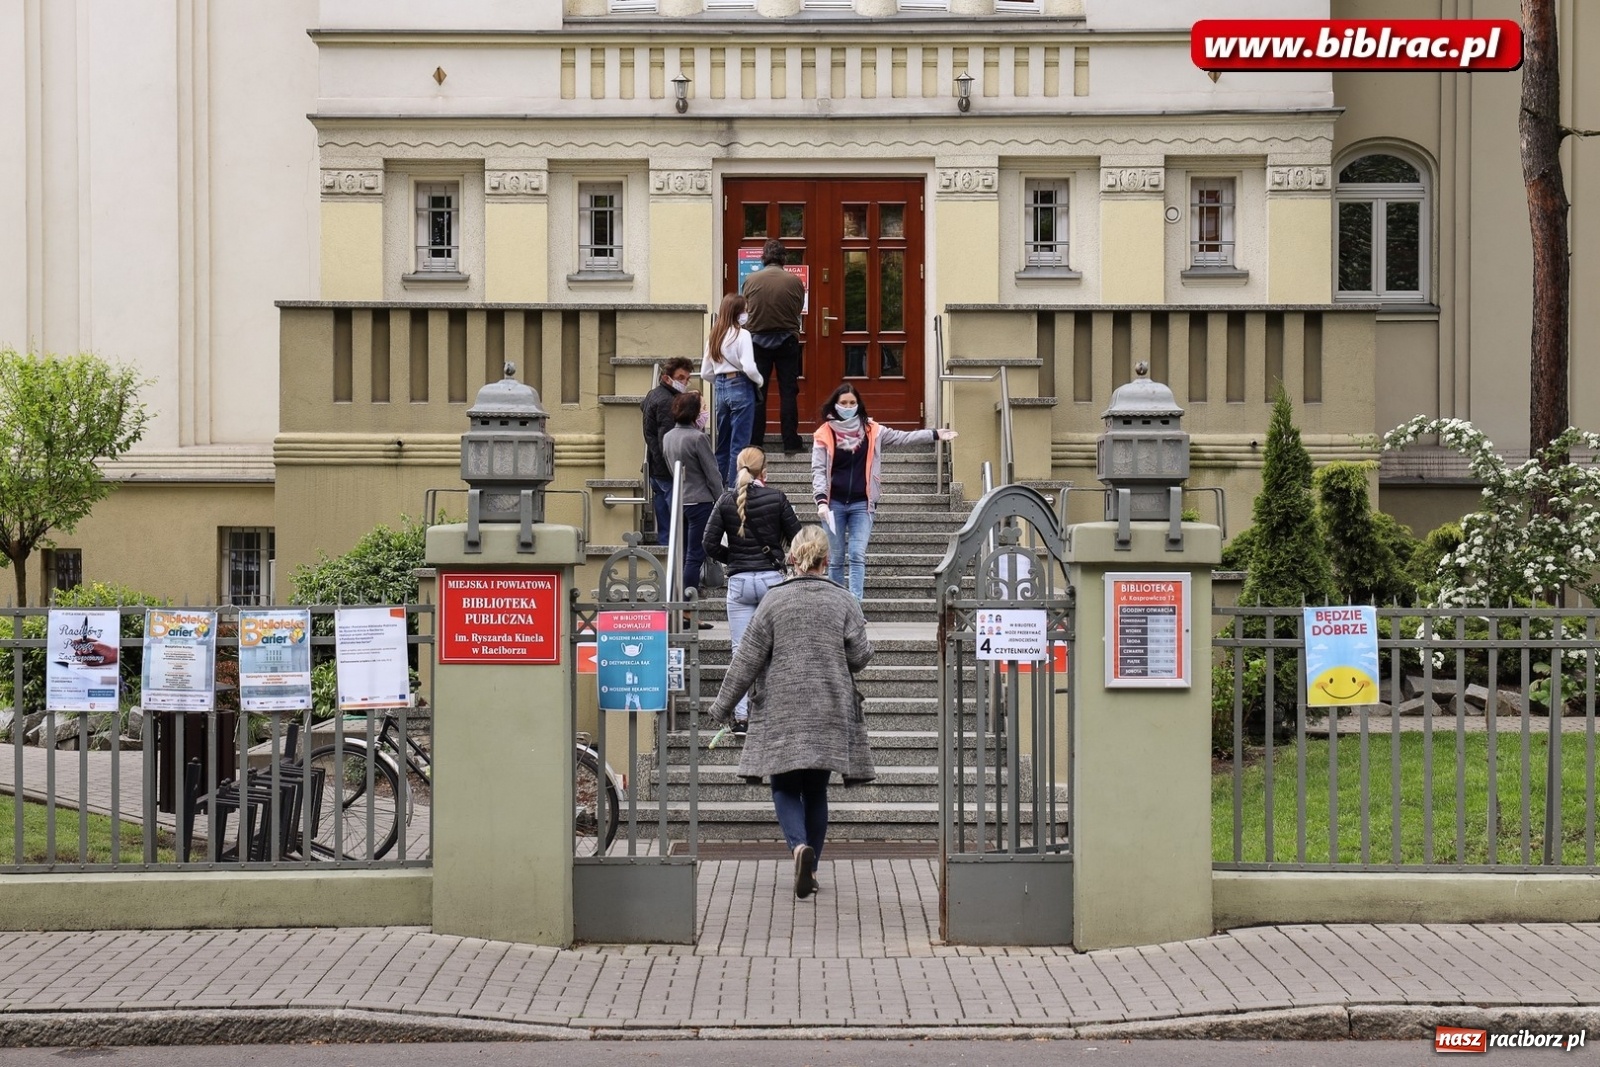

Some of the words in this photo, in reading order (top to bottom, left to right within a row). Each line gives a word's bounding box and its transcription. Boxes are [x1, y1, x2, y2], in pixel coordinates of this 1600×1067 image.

[448, 580, 489, 589] MIEJSKA
[491, 581, 494, 589] I
[496, 580, 552, 590] POWIATOWA
[1121, 583, 1175, 593] BIBLIOTEKA
[462, 597, 537, 609] BIBLIOTEKA
[150, 612, 210, 627] Biblioteka
[465, 613, 534, 625] PUBLICZNA
[1315, 609, 1362, 624] BĘDZIE
[1312, 623, 1368, 636] DOBRZE
[455, 633, 469, 642] im.
[471, 633, 512, 644] Ryszarda
[515, 633, 544, 642] Kinela
[472, 647, 480, 655] w
[481, 646, 527, 655] Raciborzu
[980, 637, 992, 654] 4
[994, 646, 1041, 655] CZYTELNIKÓW
